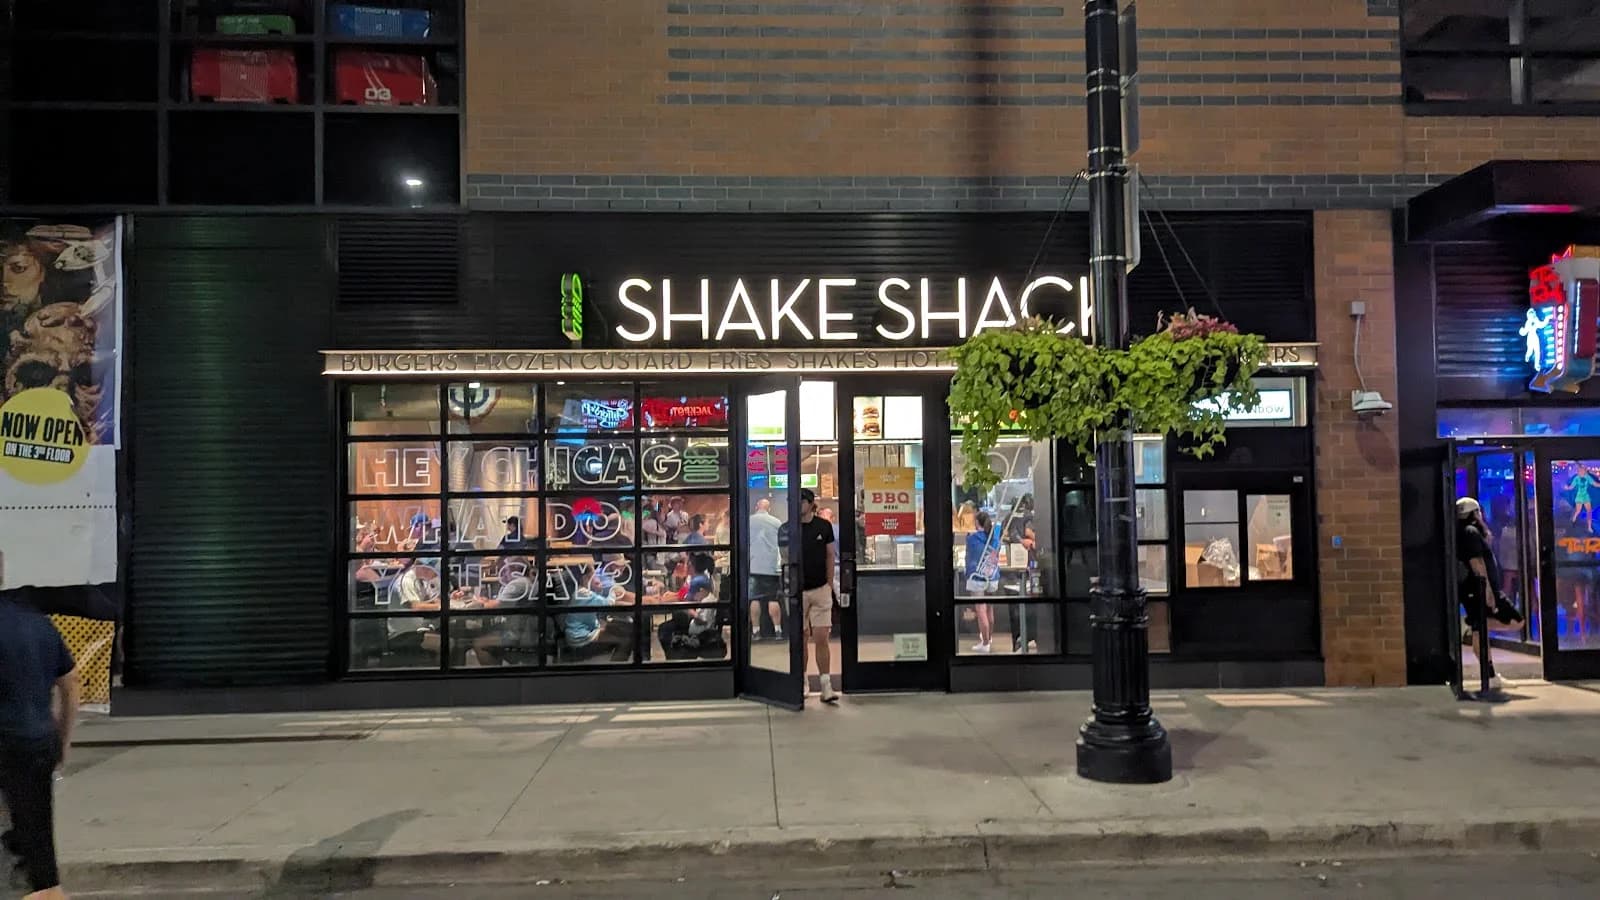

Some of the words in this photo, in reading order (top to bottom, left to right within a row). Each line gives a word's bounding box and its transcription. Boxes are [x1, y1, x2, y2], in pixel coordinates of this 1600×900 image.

[615, 277, 858, 342] SHAKE
[341, 352, 458, 372] BURGERS
[473, 352, 573, 371] FROZEN
[580, 351, 692, 370] CUSTARD
[707, 351, 772, 370] FRIES
[786, 350, 879, 369] SHAKES
[1, 411, 41, 440] NOW
[42, 417, 84, 446] OPEN
[5, 442, 17, 456] ON
[18, 443, 33, 458] THE
[45, 447, 72, 462] FLOOR
[871, 491, 910, 505] BBQ
[543, 500, 622, 542] DO
